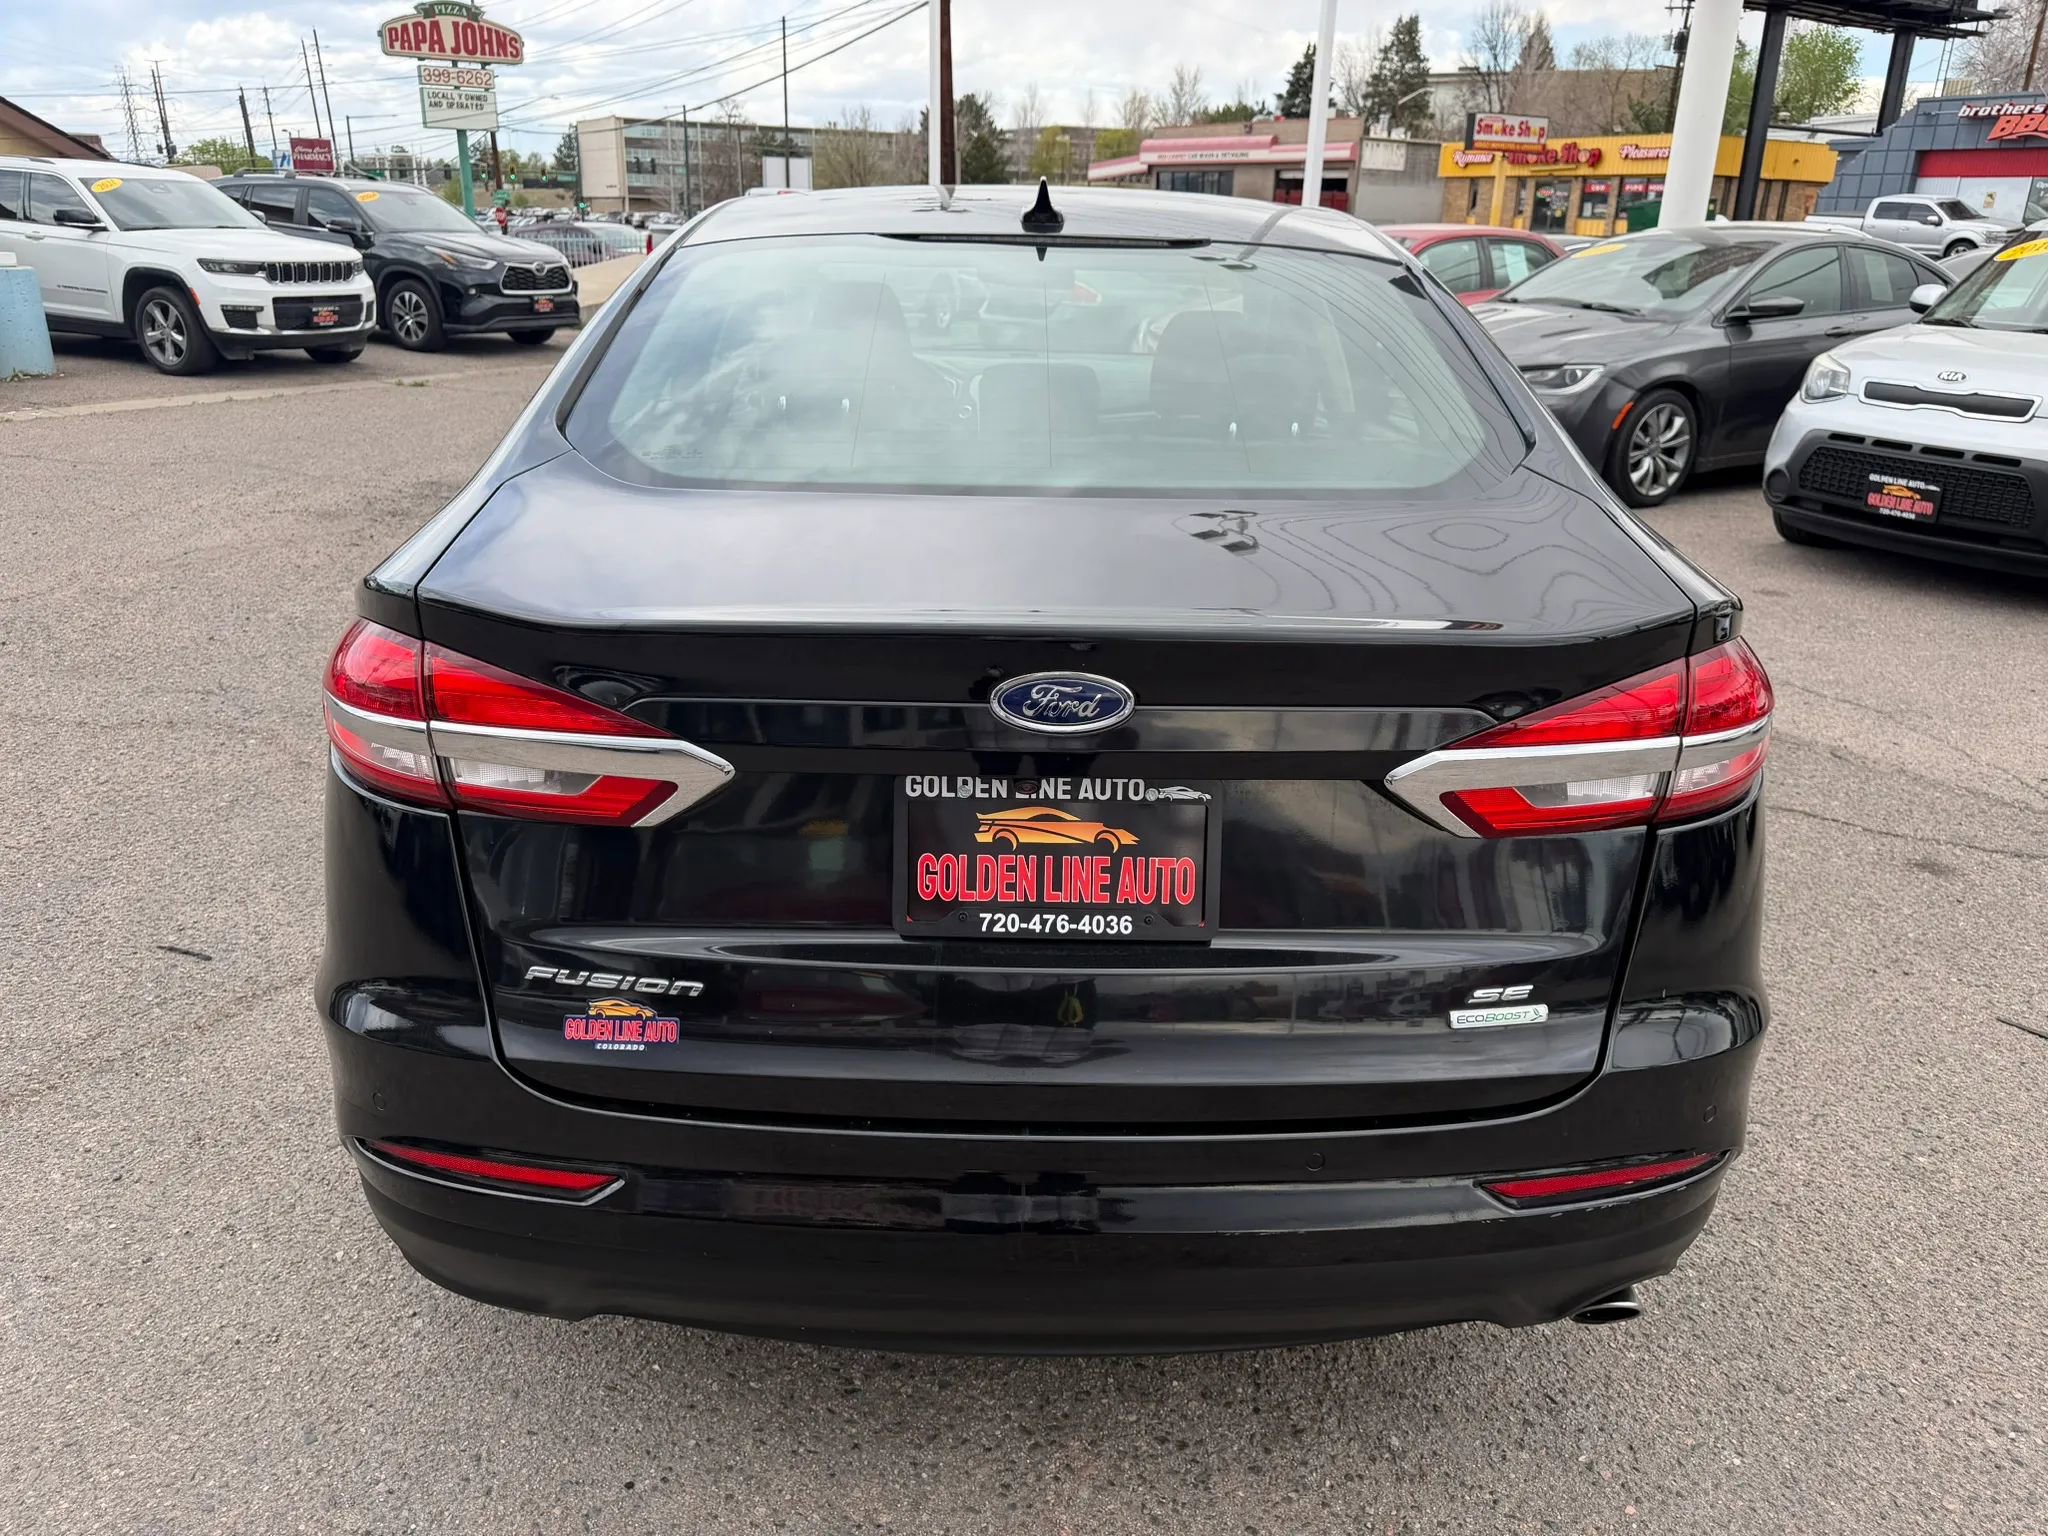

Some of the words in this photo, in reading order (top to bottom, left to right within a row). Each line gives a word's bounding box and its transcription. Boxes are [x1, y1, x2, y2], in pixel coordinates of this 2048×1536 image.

[434, 5, 468, 16] PIZZA
[387, 20, 447, 53] PAPA
[423, 68, 492, 86] 399-6262
[429, 100, 443, 109] AND
[446, 101, 485, 111] OPERATED
[1958, 103, 2047, 117] brothers
[1939, 371, 1965, 382] KIA
[1908, 480, 1926, 489] AUTO
[1022, 684, 1102, 718] Ford
[905, 775, 1007, 799] GOLDEN
[1078, 778, 1146, 801] AUTO
[917, 852, 1037, 902] GOLDEN
[1043, 855, 1110, 903] LINE
[1116, 856, 1196, 905] AUTO
[979, 912, 1133, 935] 720-476-4036
[524, 965, 704, 997] FUSION
[1467, 984, 1534, 1004] SE
[565, 1018, 614, 1041] GOLDEN
[614, 1020, 644, 1042] LINE
[643, 1020, 678, 1043] AUTO
[596, 1043, 646, 1051] COLORADO
